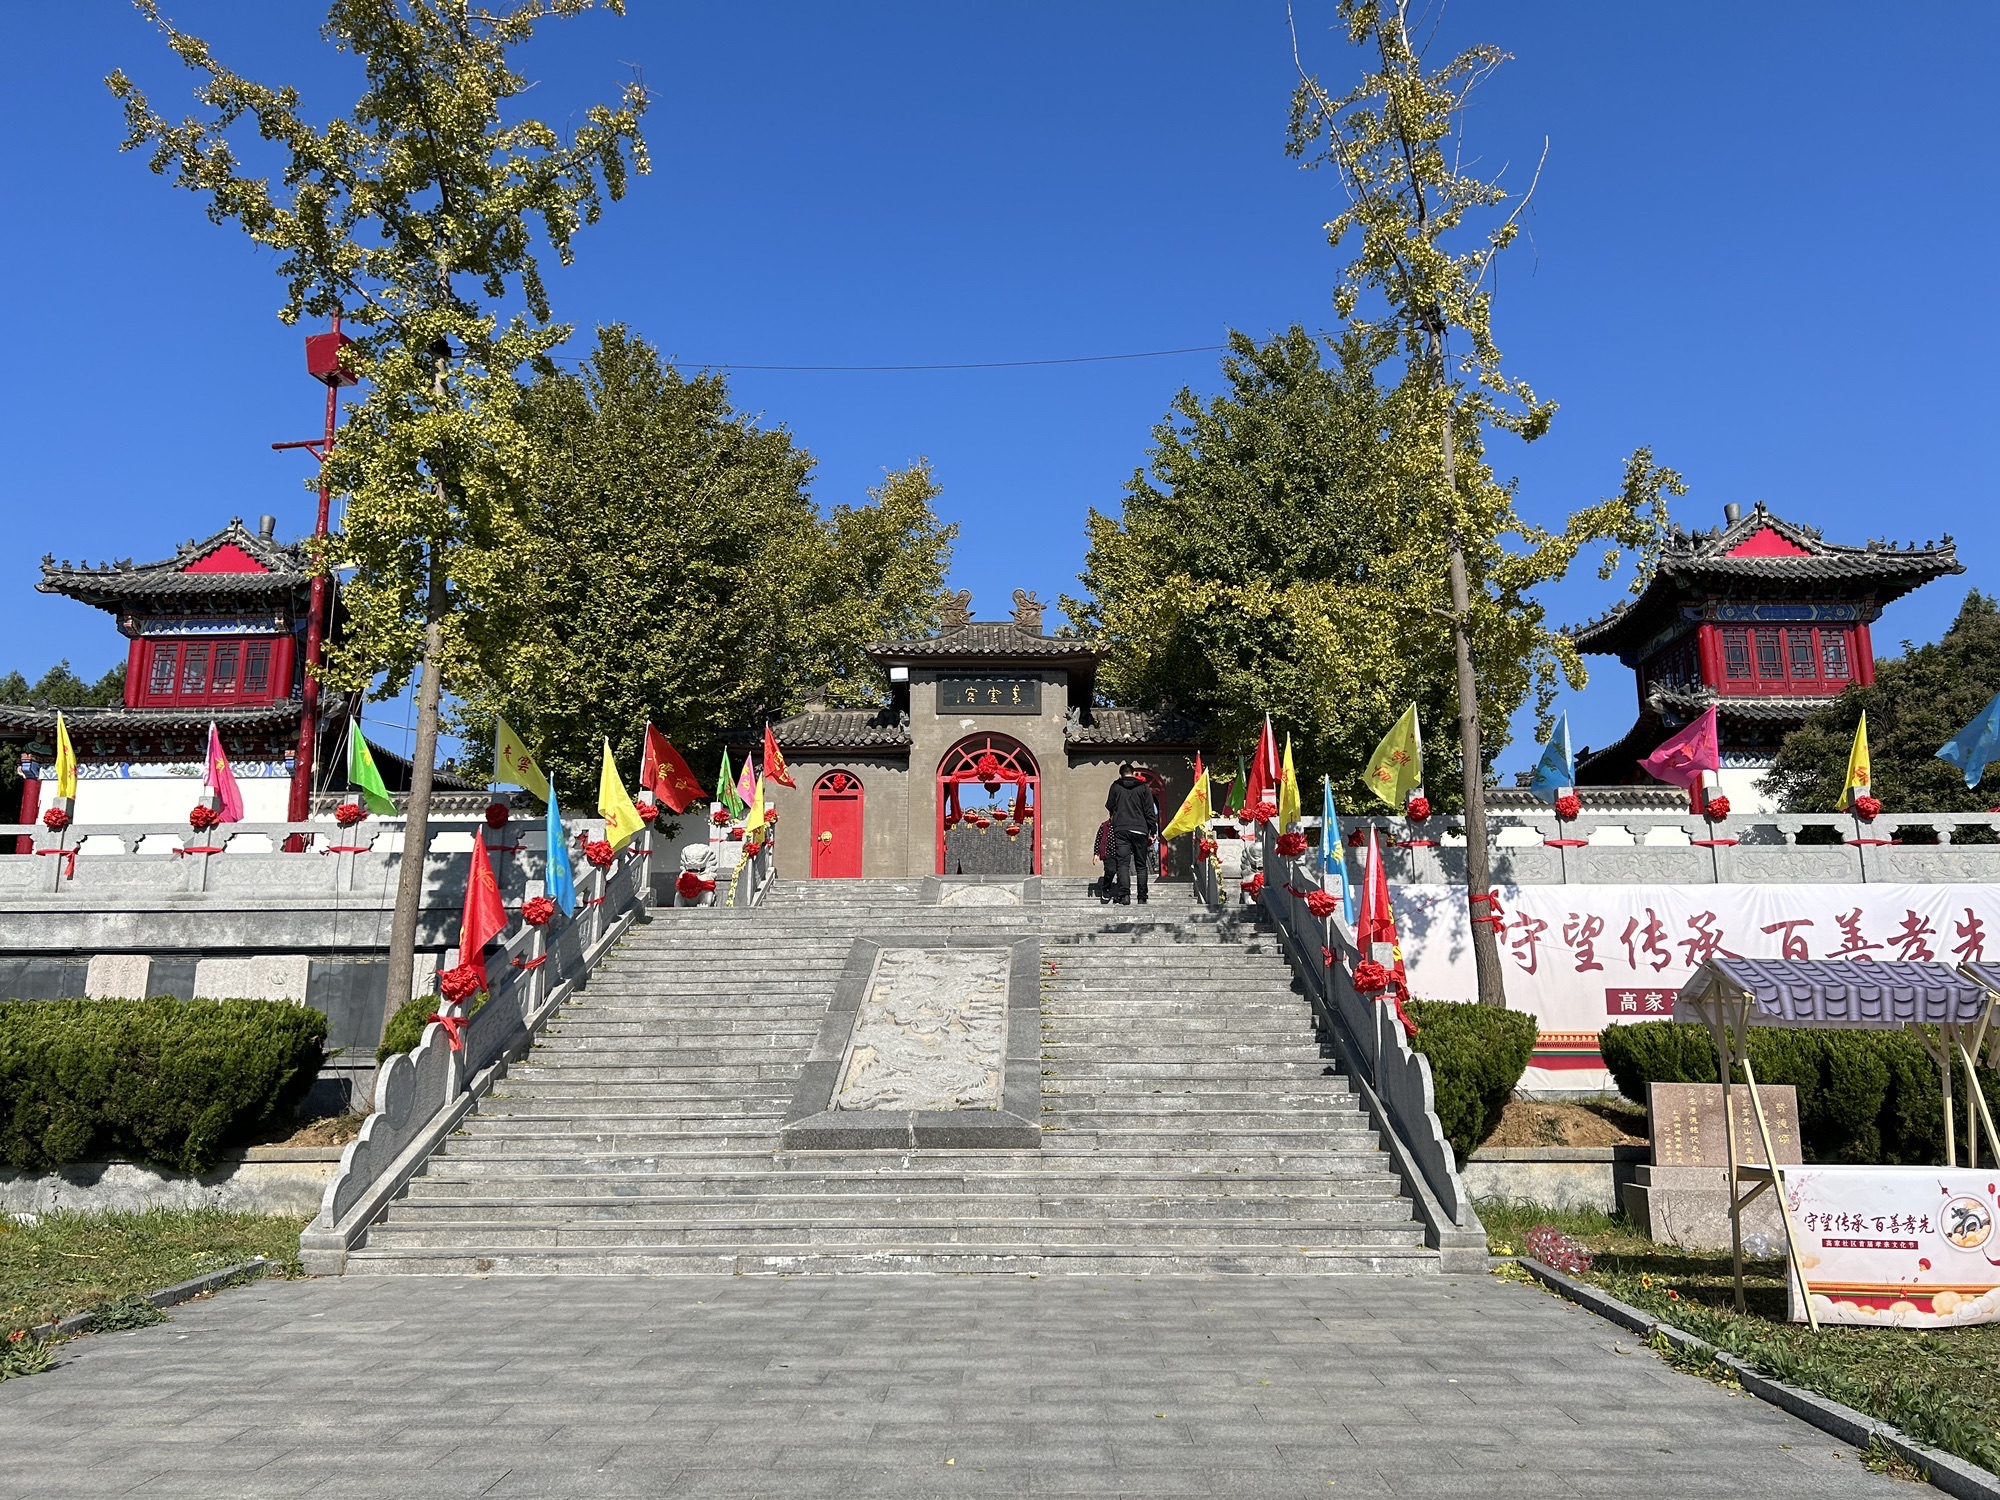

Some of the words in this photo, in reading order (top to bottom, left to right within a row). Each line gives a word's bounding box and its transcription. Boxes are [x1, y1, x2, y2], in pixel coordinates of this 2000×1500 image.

[1500, 908, 1746, 975] 守望传承
[1804, 1212, 1869, 1233] 守望传承
[1871, 1213, 1936, 1234] 百善孝先
